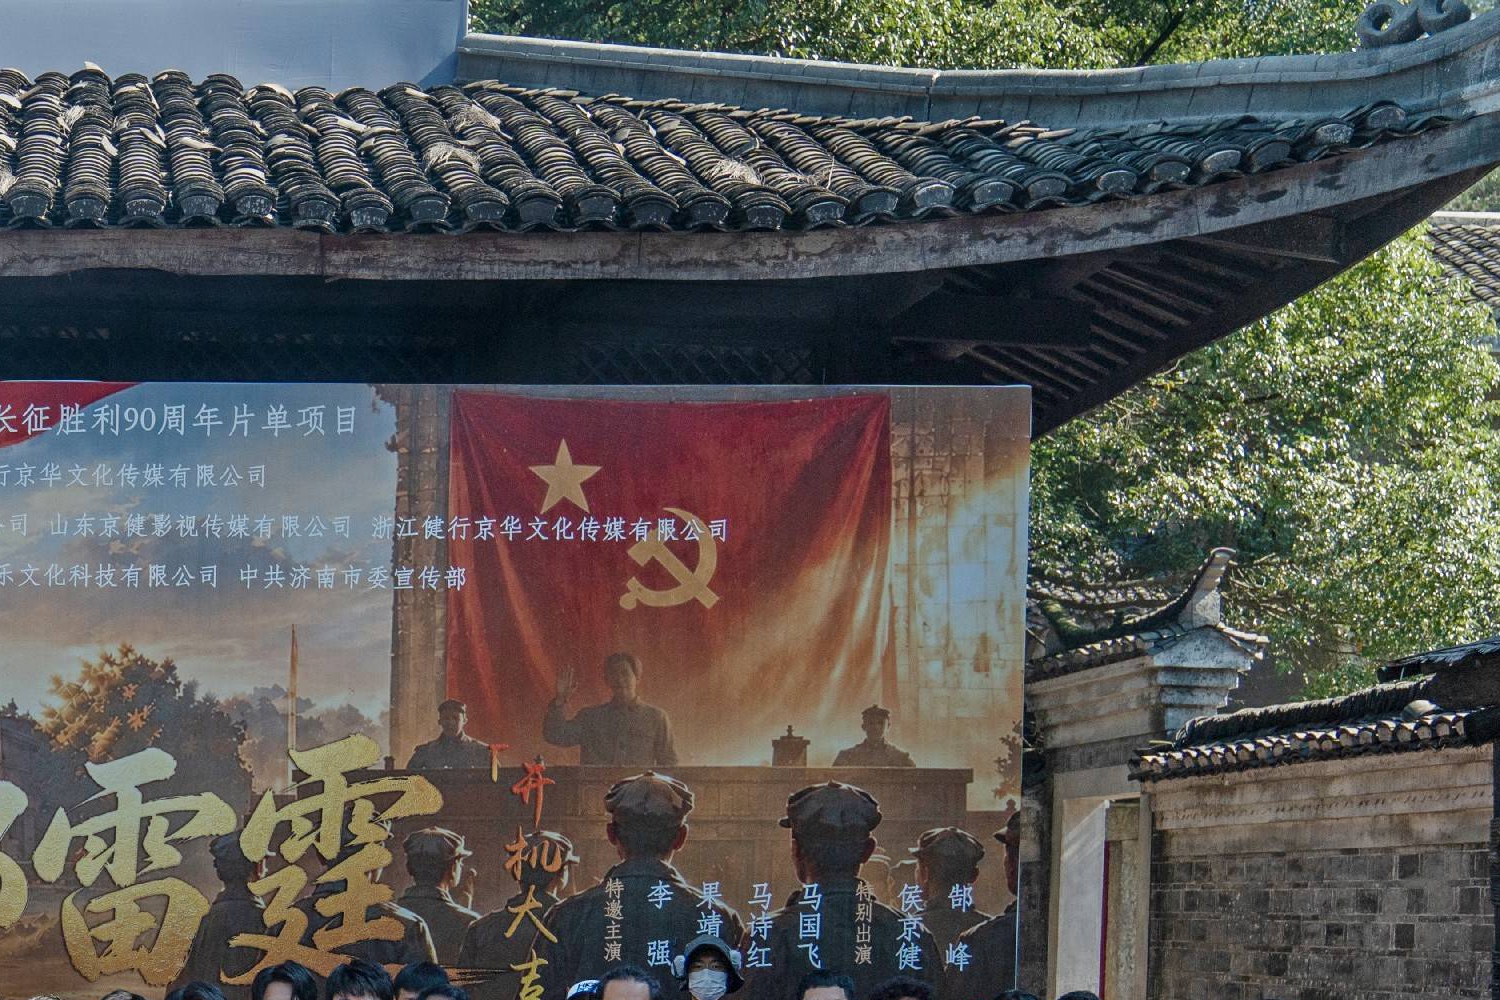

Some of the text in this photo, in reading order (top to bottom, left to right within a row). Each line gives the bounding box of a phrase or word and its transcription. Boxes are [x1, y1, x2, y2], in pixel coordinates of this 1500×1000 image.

[50, 512, 351, 539] 山东京健影视传媒有限公司
[371, 514, 728, 542] 浙江健行京华文化传媒有限公司
[240, 563, 467, 592] 中共济南市委宣传部
[604, 878, 625, 962] 特邀主演
[647, 879, 673, 968] 李强
[696, 880, 723, 938] 果靖
[746, 882, 773, 969] 马诗红
[798, 882, 823, 969] 马国飞
[855, 881, 874, 965] 特别出演
[895, 883, 923, 970] 侯京健
